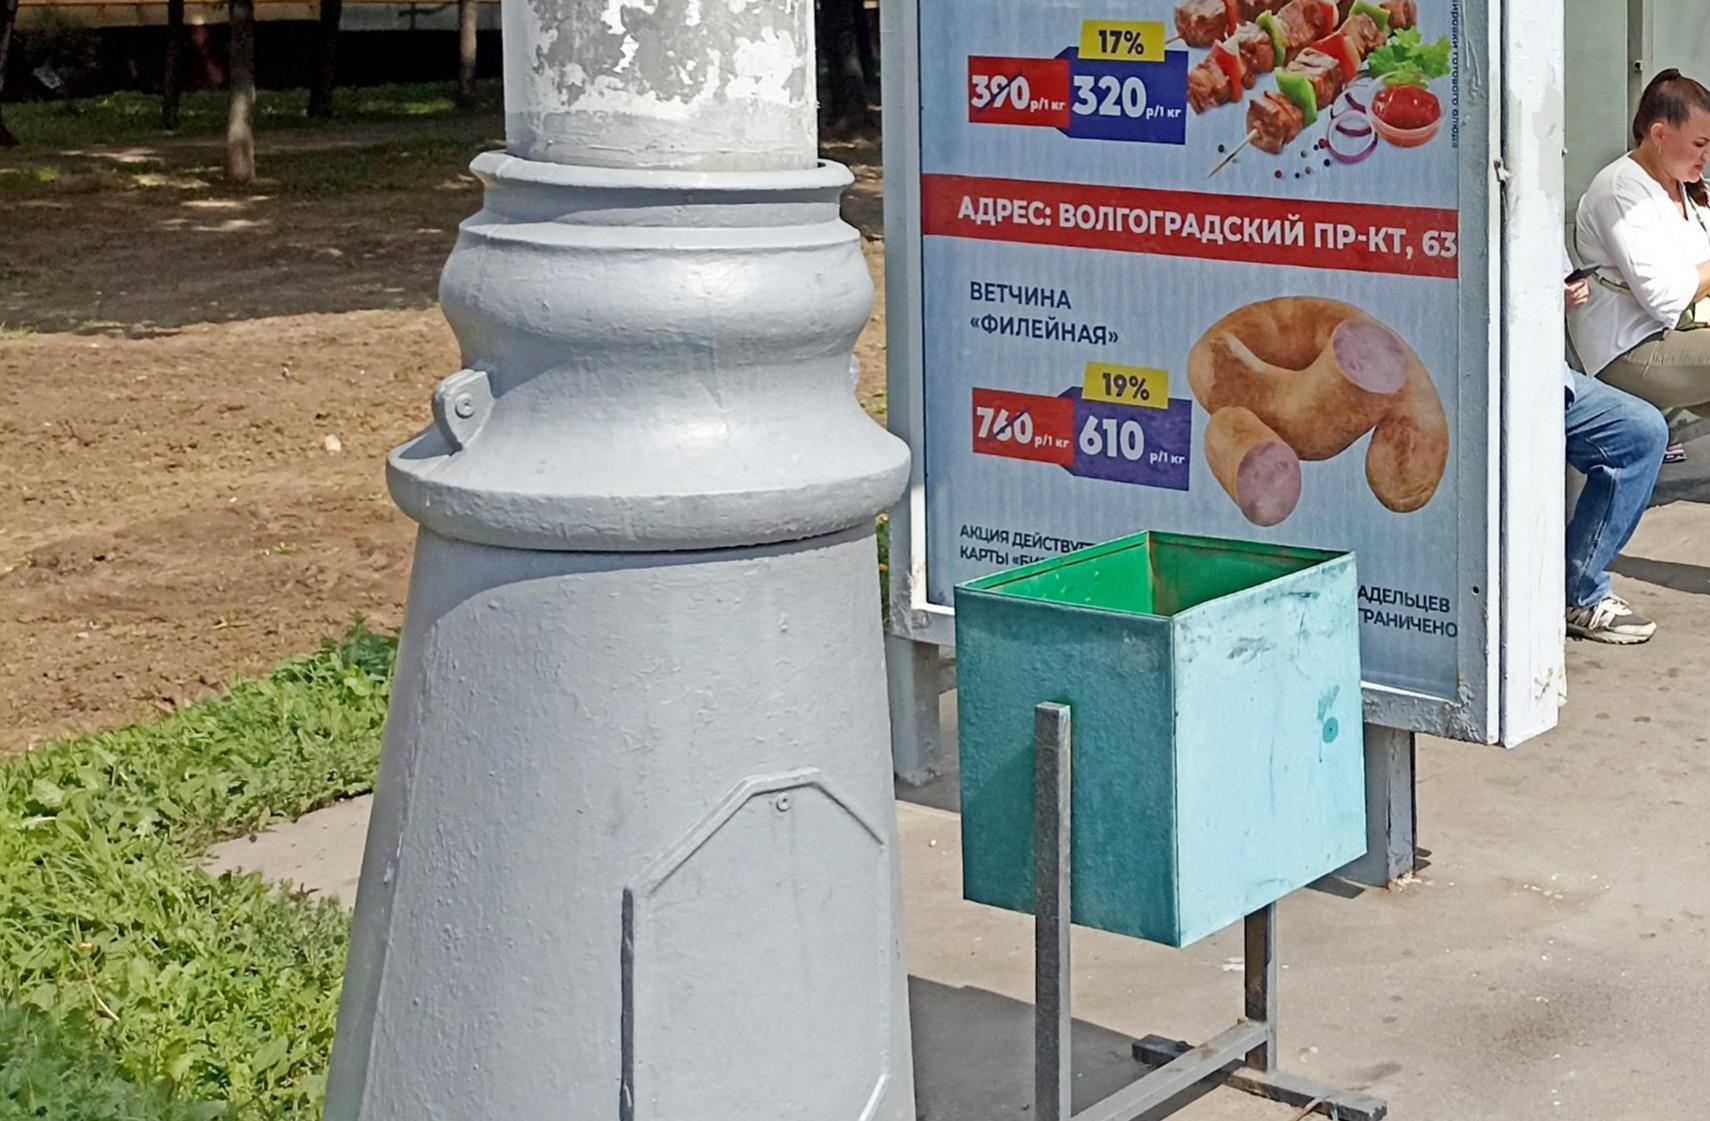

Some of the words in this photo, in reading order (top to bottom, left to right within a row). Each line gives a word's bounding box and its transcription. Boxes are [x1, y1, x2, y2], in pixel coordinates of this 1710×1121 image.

[1098, 28, 1145, 56] 17%
[970, 75, 1031, 110] 390
[1072, 75, 1147, 119] 320
[958, 195, 1053, 227] АДРЕС:
[1059, 202, 1305, 248] ВОЛГОГРАДСКИЙ
[1314, 221, 1414, 260] ПР-КТ,
[1421, 229, 1457, 259] 63
[969, 281, 1072, 311] ВЕТЧИНА
[969, 313, 1119, 346] «ФИЛЕЙНАЯ»
[1101, 372, 1150, 401] 19%
[976, 406, 1033, 444] 760
[1079, 415, 1145, 461] 610
[960, 524, 1009, 544] АКЦИЯ
[1012, 531, 1096, 554] ДЕЙСТВУ
[960, 546, 1009, 565] КАРТЫ
[1358, 584, 1450, 613] АДЕЛЬЦЕВ
[1358, 607, 1458, 638] РАНИЧЕНО
